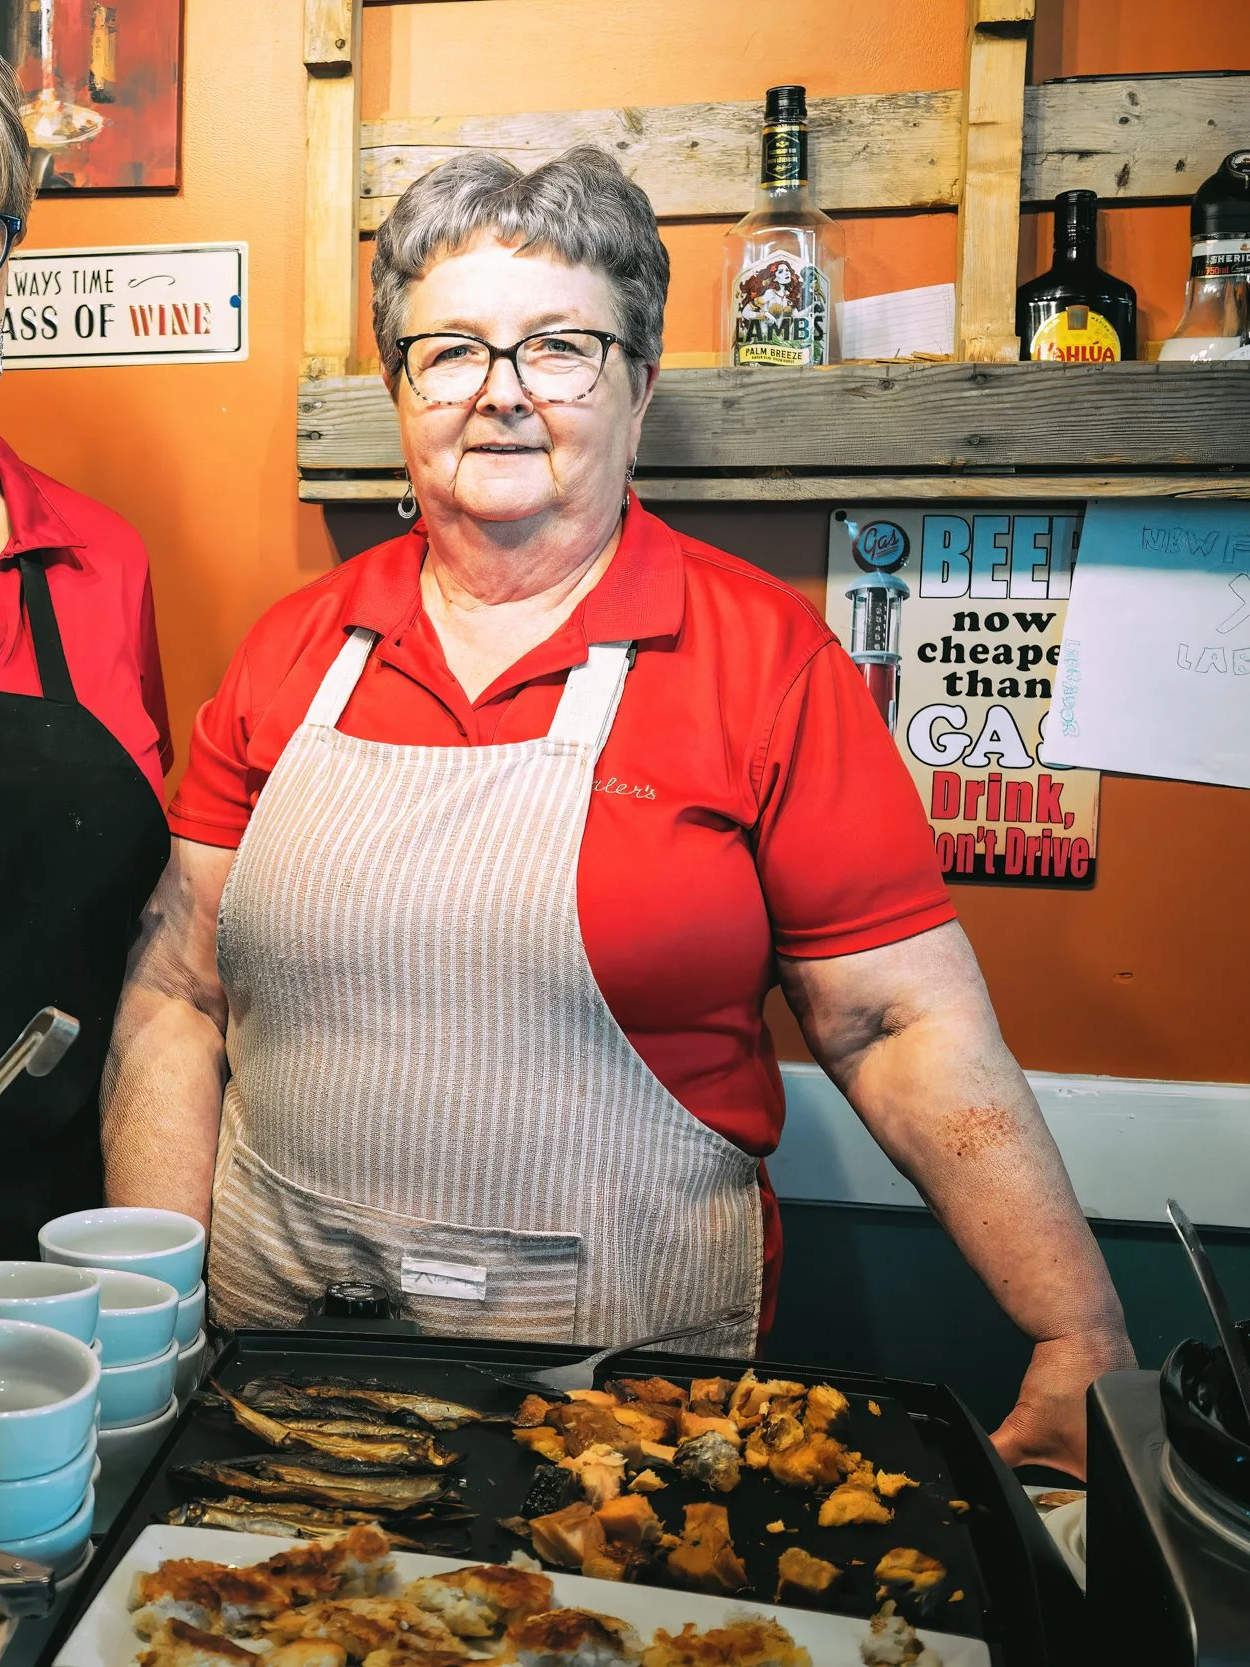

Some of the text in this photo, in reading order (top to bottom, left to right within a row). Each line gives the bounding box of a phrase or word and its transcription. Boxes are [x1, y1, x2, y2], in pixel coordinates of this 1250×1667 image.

[72, 269, 114, 295] TIME
[74, 303, 116, 339] OF
[129, 301, 212, 337] WINE
[745, 346, 767, 357] PALM
[770, 348, 803, 360] BREEZE
[863, 526, 900, 560] Gas
[952, 611, 1057, 633] now
[943, 670, 1053, 698] than
[907, 703, 1076, 770] GA
[931, 771, 1075, 830] Drink,
[1004, 827, 1090, 879] Drive
